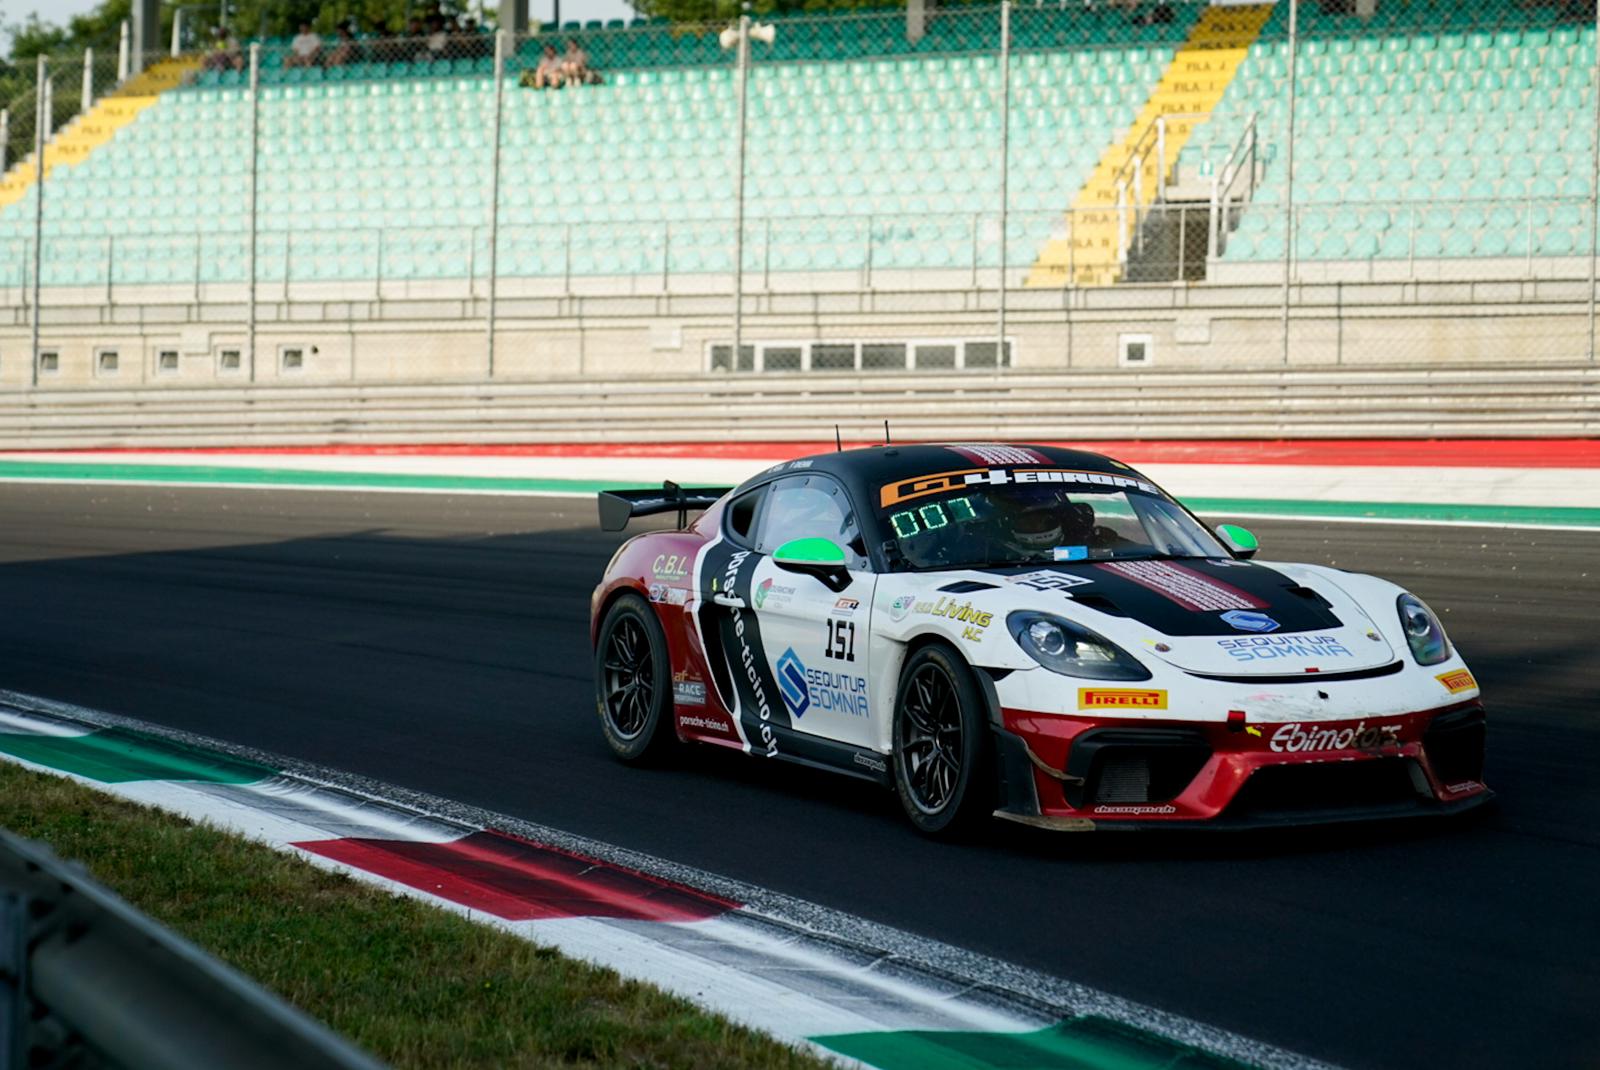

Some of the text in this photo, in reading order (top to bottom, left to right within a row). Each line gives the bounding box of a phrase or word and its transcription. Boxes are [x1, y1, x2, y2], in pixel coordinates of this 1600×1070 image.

[825, 618, 855, 662] 151
[1217, 635, 1340, 650] SEQUITUR
[1228, 644, 1354, 662] SOMNIA
[679, 683, 701, 696] RACE
[806, 668, 866, 695] SEQUITUR
[809, 686, 869, 719] SOMNIA
[1085, 691, 1160, 705] PIRELLI
